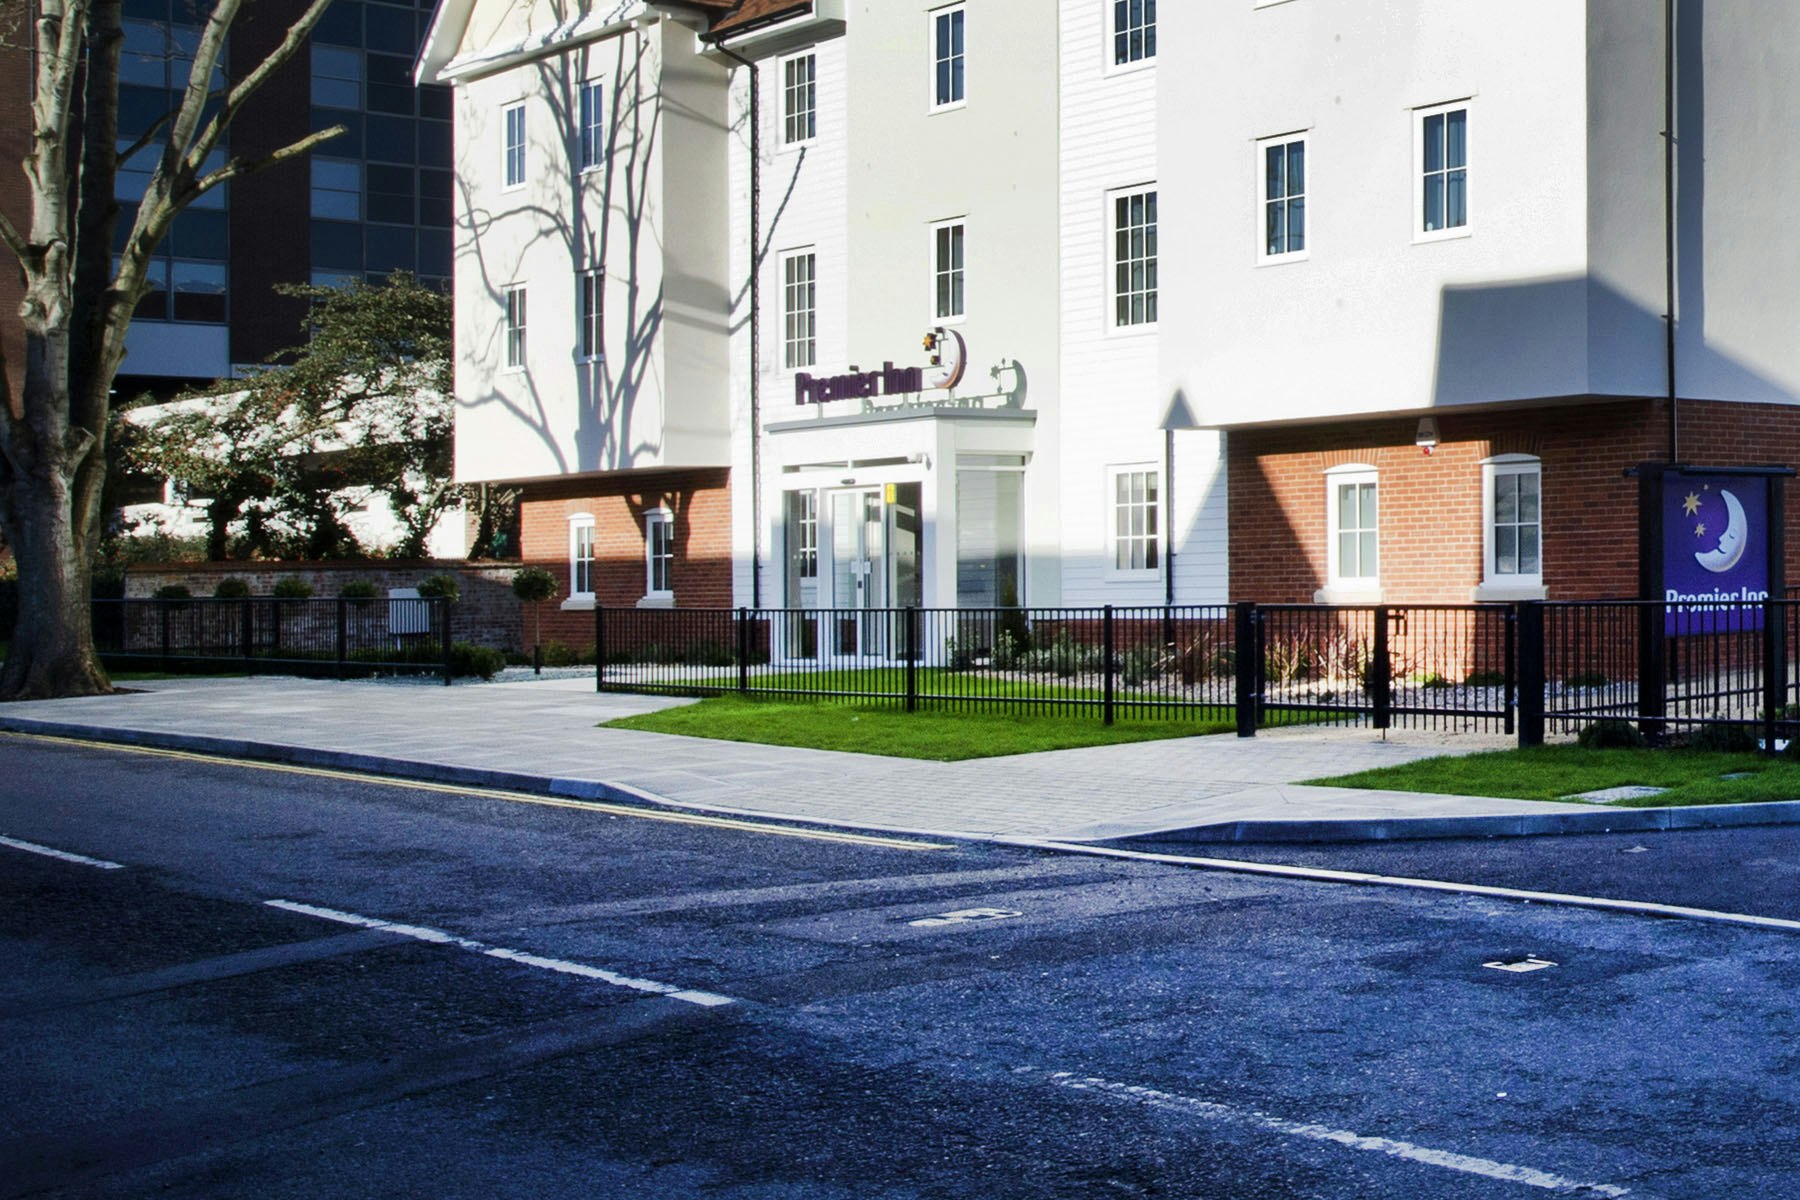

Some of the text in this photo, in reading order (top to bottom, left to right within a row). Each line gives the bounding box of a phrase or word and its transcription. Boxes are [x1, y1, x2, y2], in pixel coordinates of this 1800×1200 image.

[795, 361, 923, 405] Premier Inn
[1666, 587, 1739, 613] Premier
